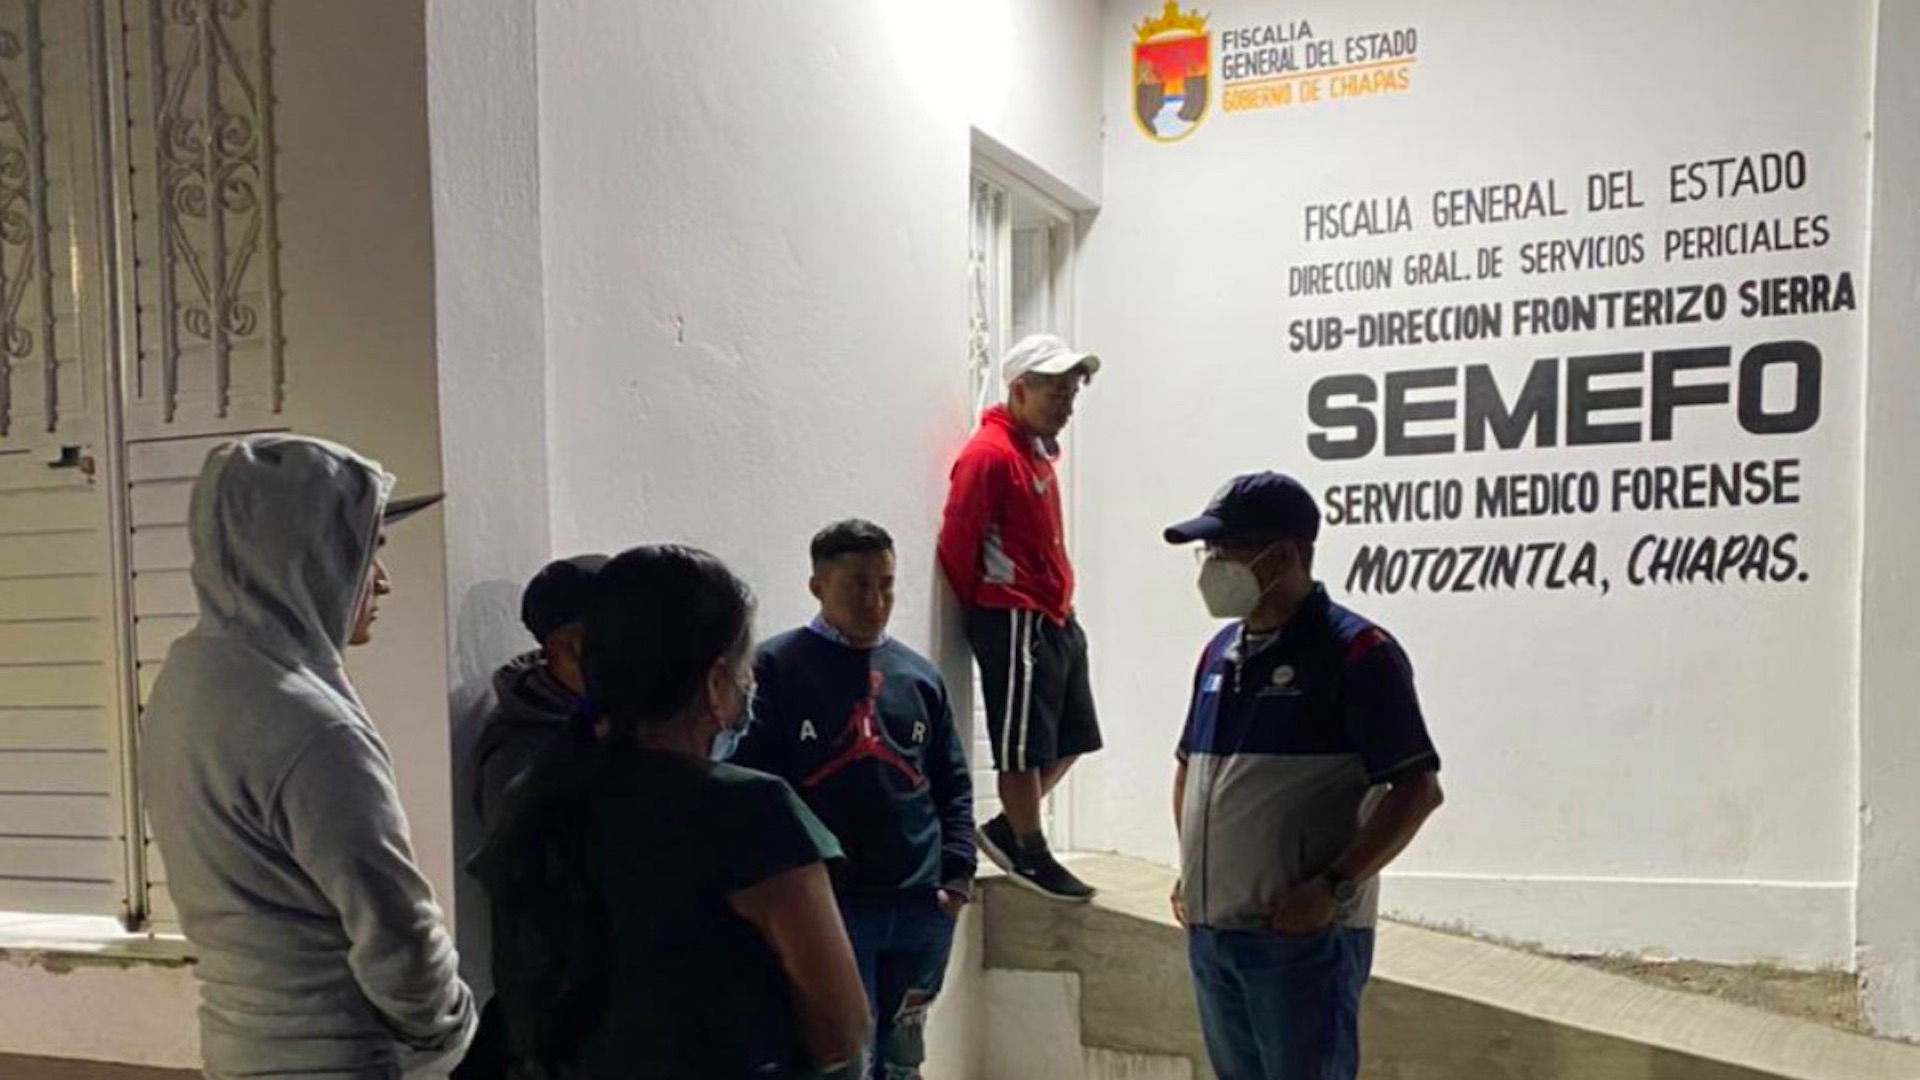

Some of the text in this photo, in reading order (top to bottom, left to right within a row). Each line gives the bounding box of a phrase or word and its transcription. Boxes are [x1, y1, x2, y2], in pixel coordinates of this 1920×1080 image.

[1221, 21, 1313, 50] FISCALIA
[1222, 27, 1418, 80] GENERAL DEL ESTADO
[1222, 68, 1410, 112] GOBIERNO DE CHIAPAS
[1305, 150, 1807, 242] FISCALIA GENERAL DEL ESTADO
[1289, 257, 1392, 297] DIRECCION
[1477, 248, 1503, 279] DE
[1520, 233, 1645, 274] SERVICIOS
[1665, 215, 1831, 262] PERICIALES
[1289, 272, 1857, 353] SUB-DIRECCION FRONTERIZO SIERRA
[1307, 340, 1823, 461] SEMEFO
[1325, 458, 1801, 525] SERVICIO MEDICO FORENSE
[1345, 533, 1810, 595] MOTOZINTLA, CHIAPAS.
